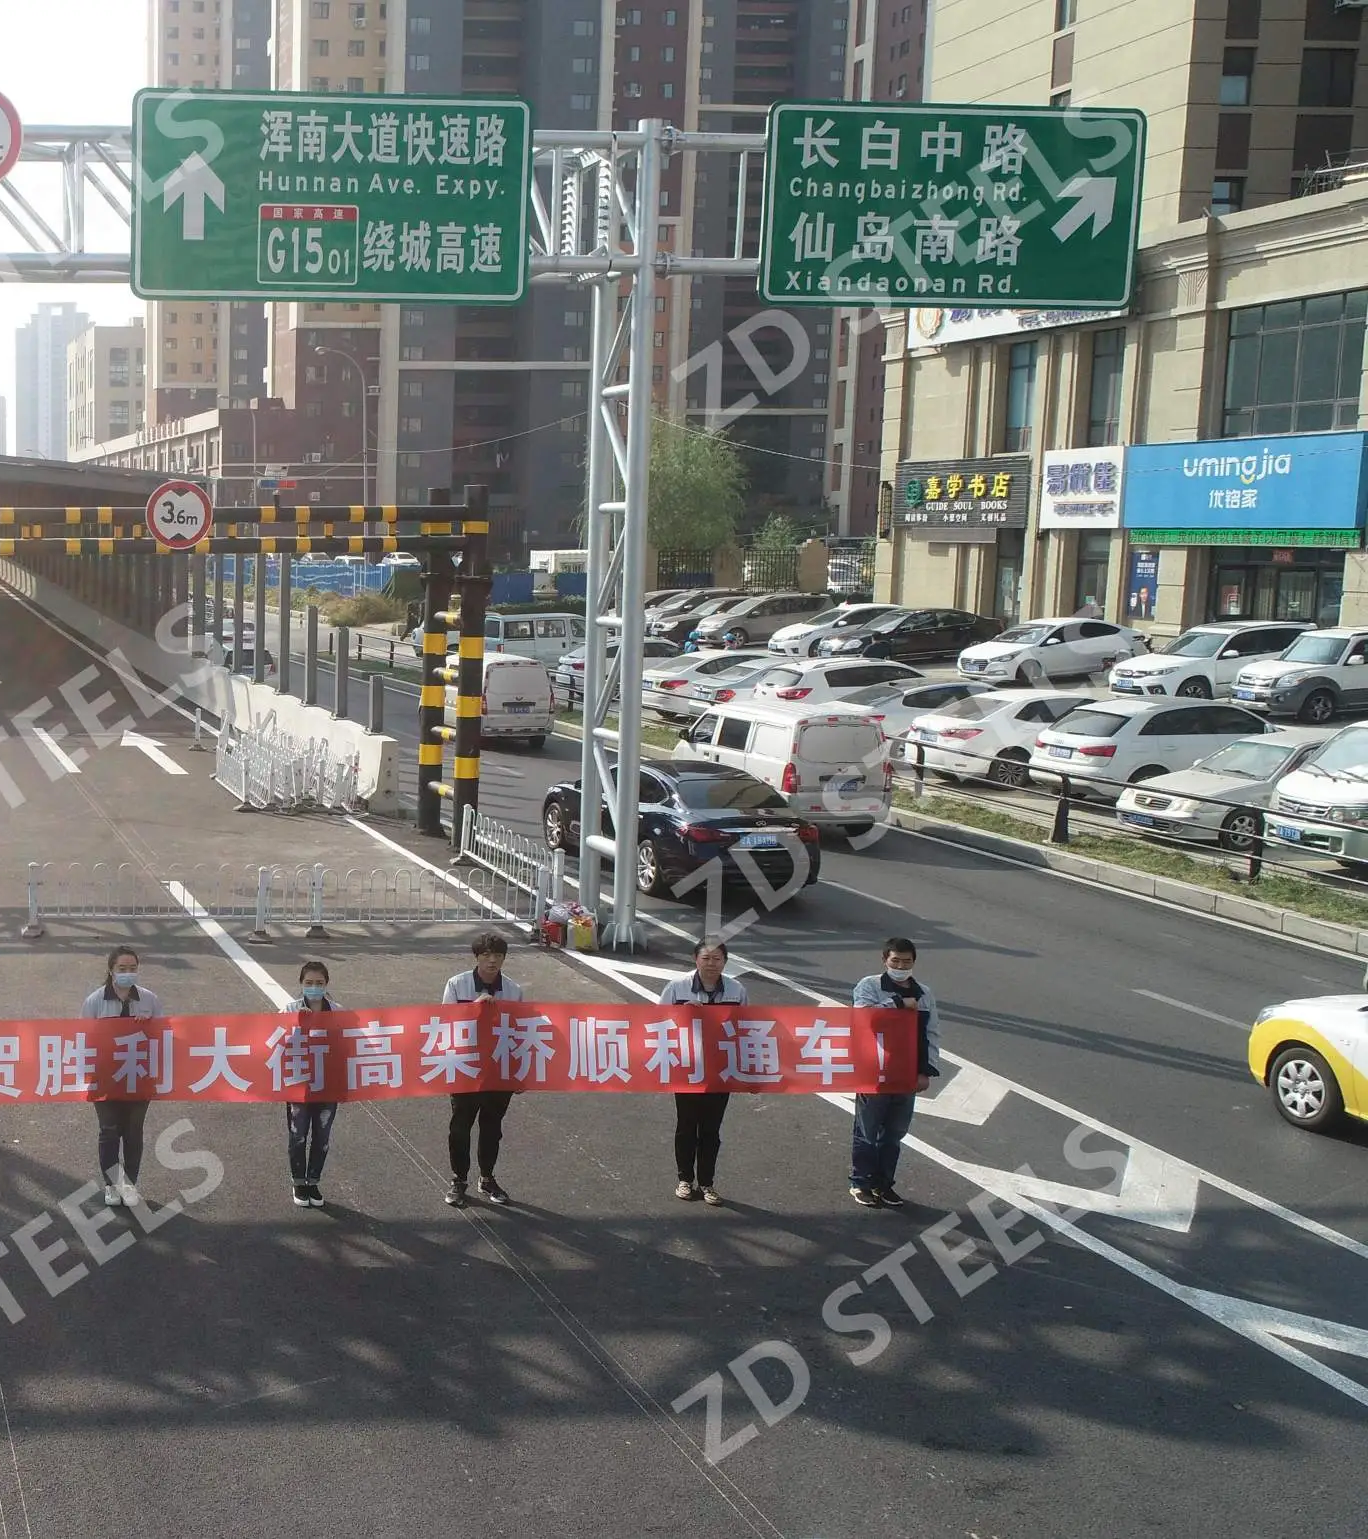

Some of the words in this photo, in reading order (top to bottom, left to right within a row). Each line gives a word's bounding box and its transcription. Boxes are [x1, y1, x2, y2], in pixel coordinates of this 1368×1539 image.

[259, 109, 508, 168] 浑南大道快速路
[792, 117, 1028, 175] 长白中路
[259, 170, 359, 194] Hunnan
[368, 173, 421, 195] Ave.
[436, 173, 506, 200] Expy.
[789, 177, 984, 205] Changbaizhong
[993, 181, 1028, 203] Rd.
[272, 207, 344, 220] 国家高速
[267, 227, 350, 275] G1501
[362, 220, 503, 274] 绕城高速
[788, 211, 1024, 266] 仙岛南路
[785, 270, 966, 295] Xiandaonan
[977, 274, 1020, 296] Rd.
[925, 472, 1011, 500] 嘉学书店
[1208, 489, 1258, 509] 优铭家
[161, 500, 200, 528] 3.6m
[925, 502, 949, 511] GUIDE
[953, 501, 974, 511] SOUL
[980, 500, 1008, 510] BOOKS
